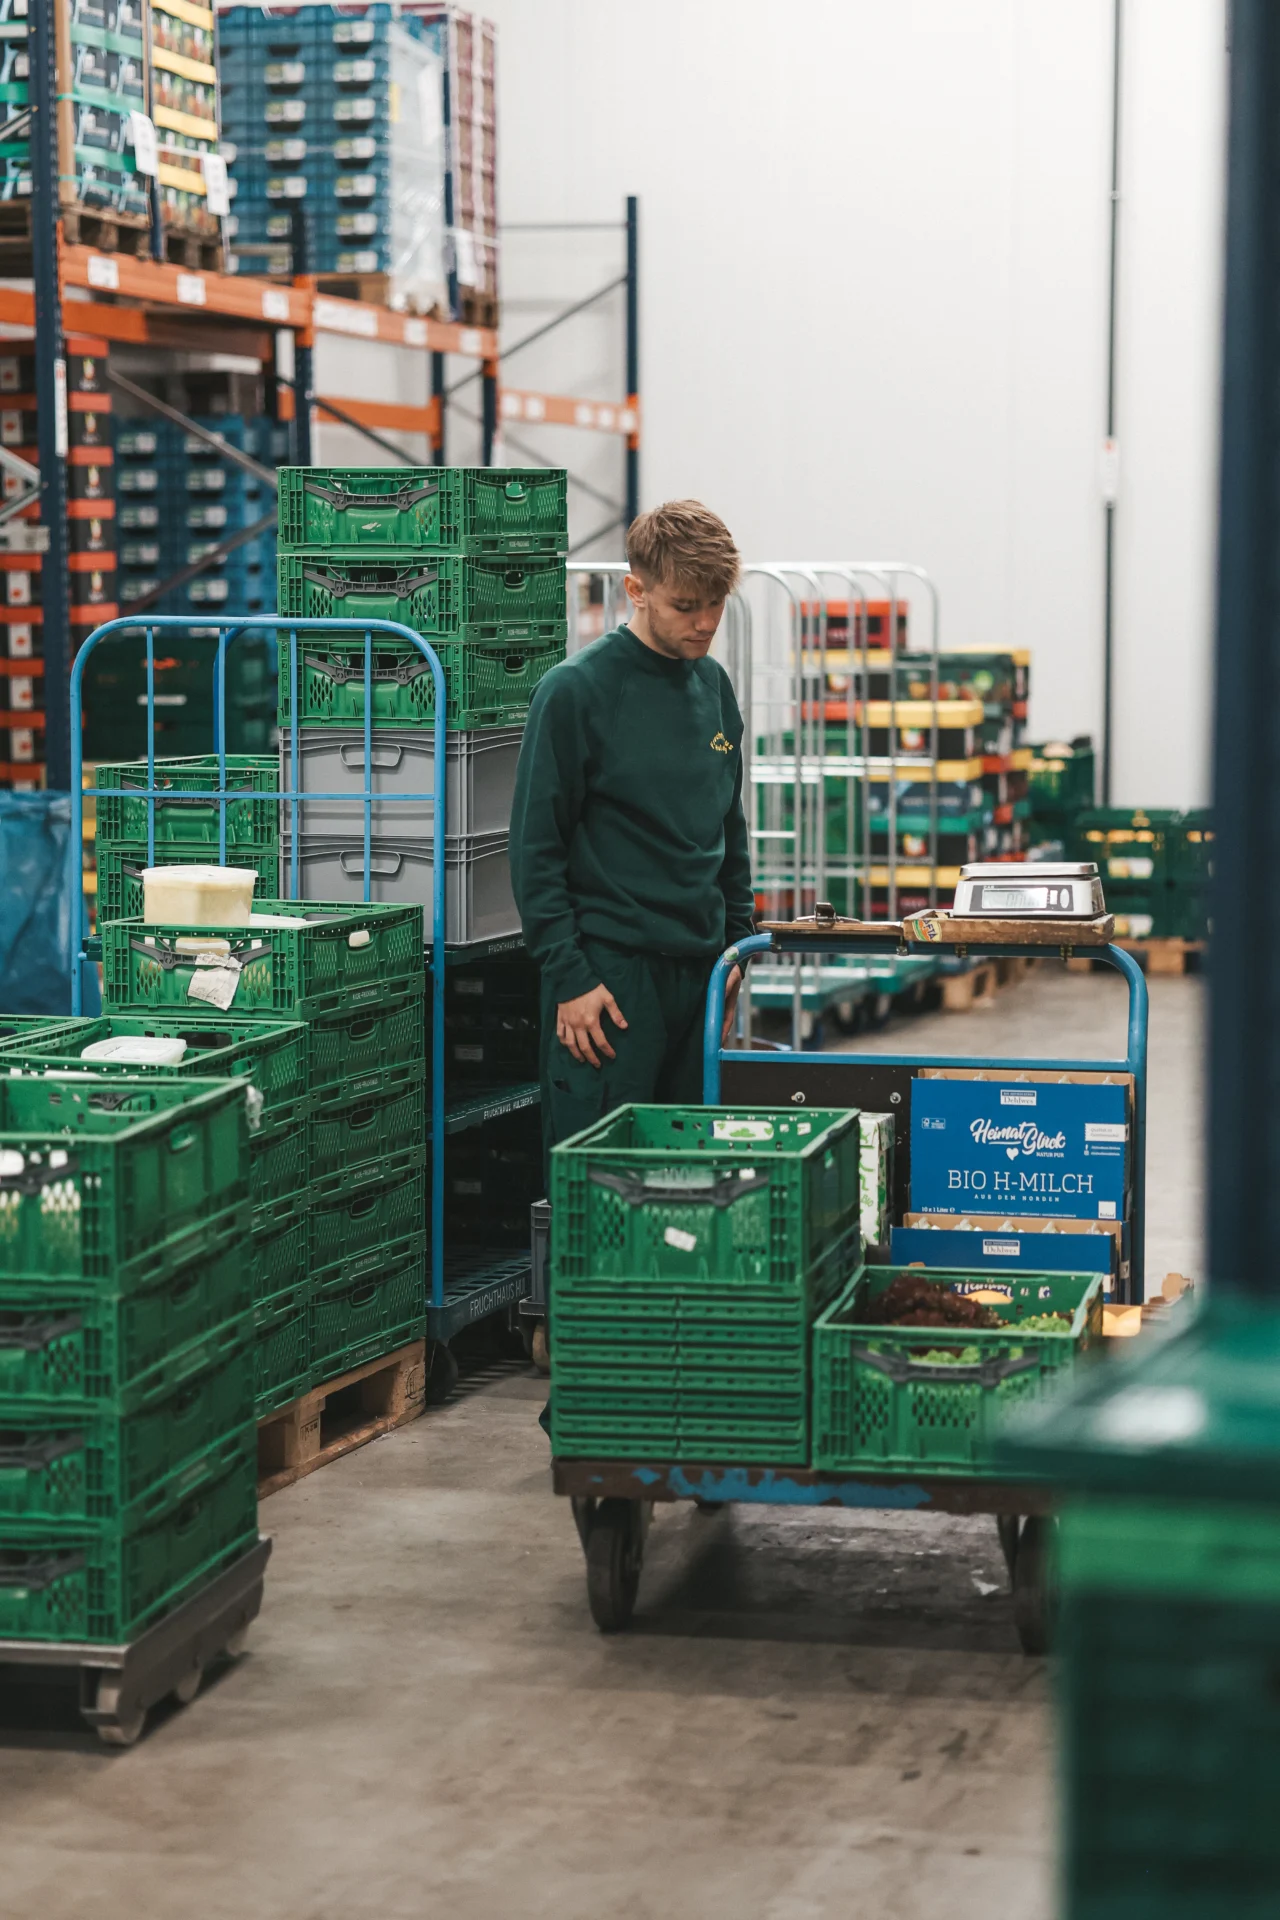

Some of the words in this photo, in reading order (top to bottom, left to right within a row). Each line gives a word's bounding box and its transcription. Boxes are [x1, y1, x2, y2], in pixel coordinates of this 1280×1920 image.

[969, 1118, 1036, 1144] Heimat
[947, 1169, 987, 1190] BIO
[993, 1171, 1094, 1194] H-MILCH
[469, 1282, 515, 1318] FRUCHTHAUS
